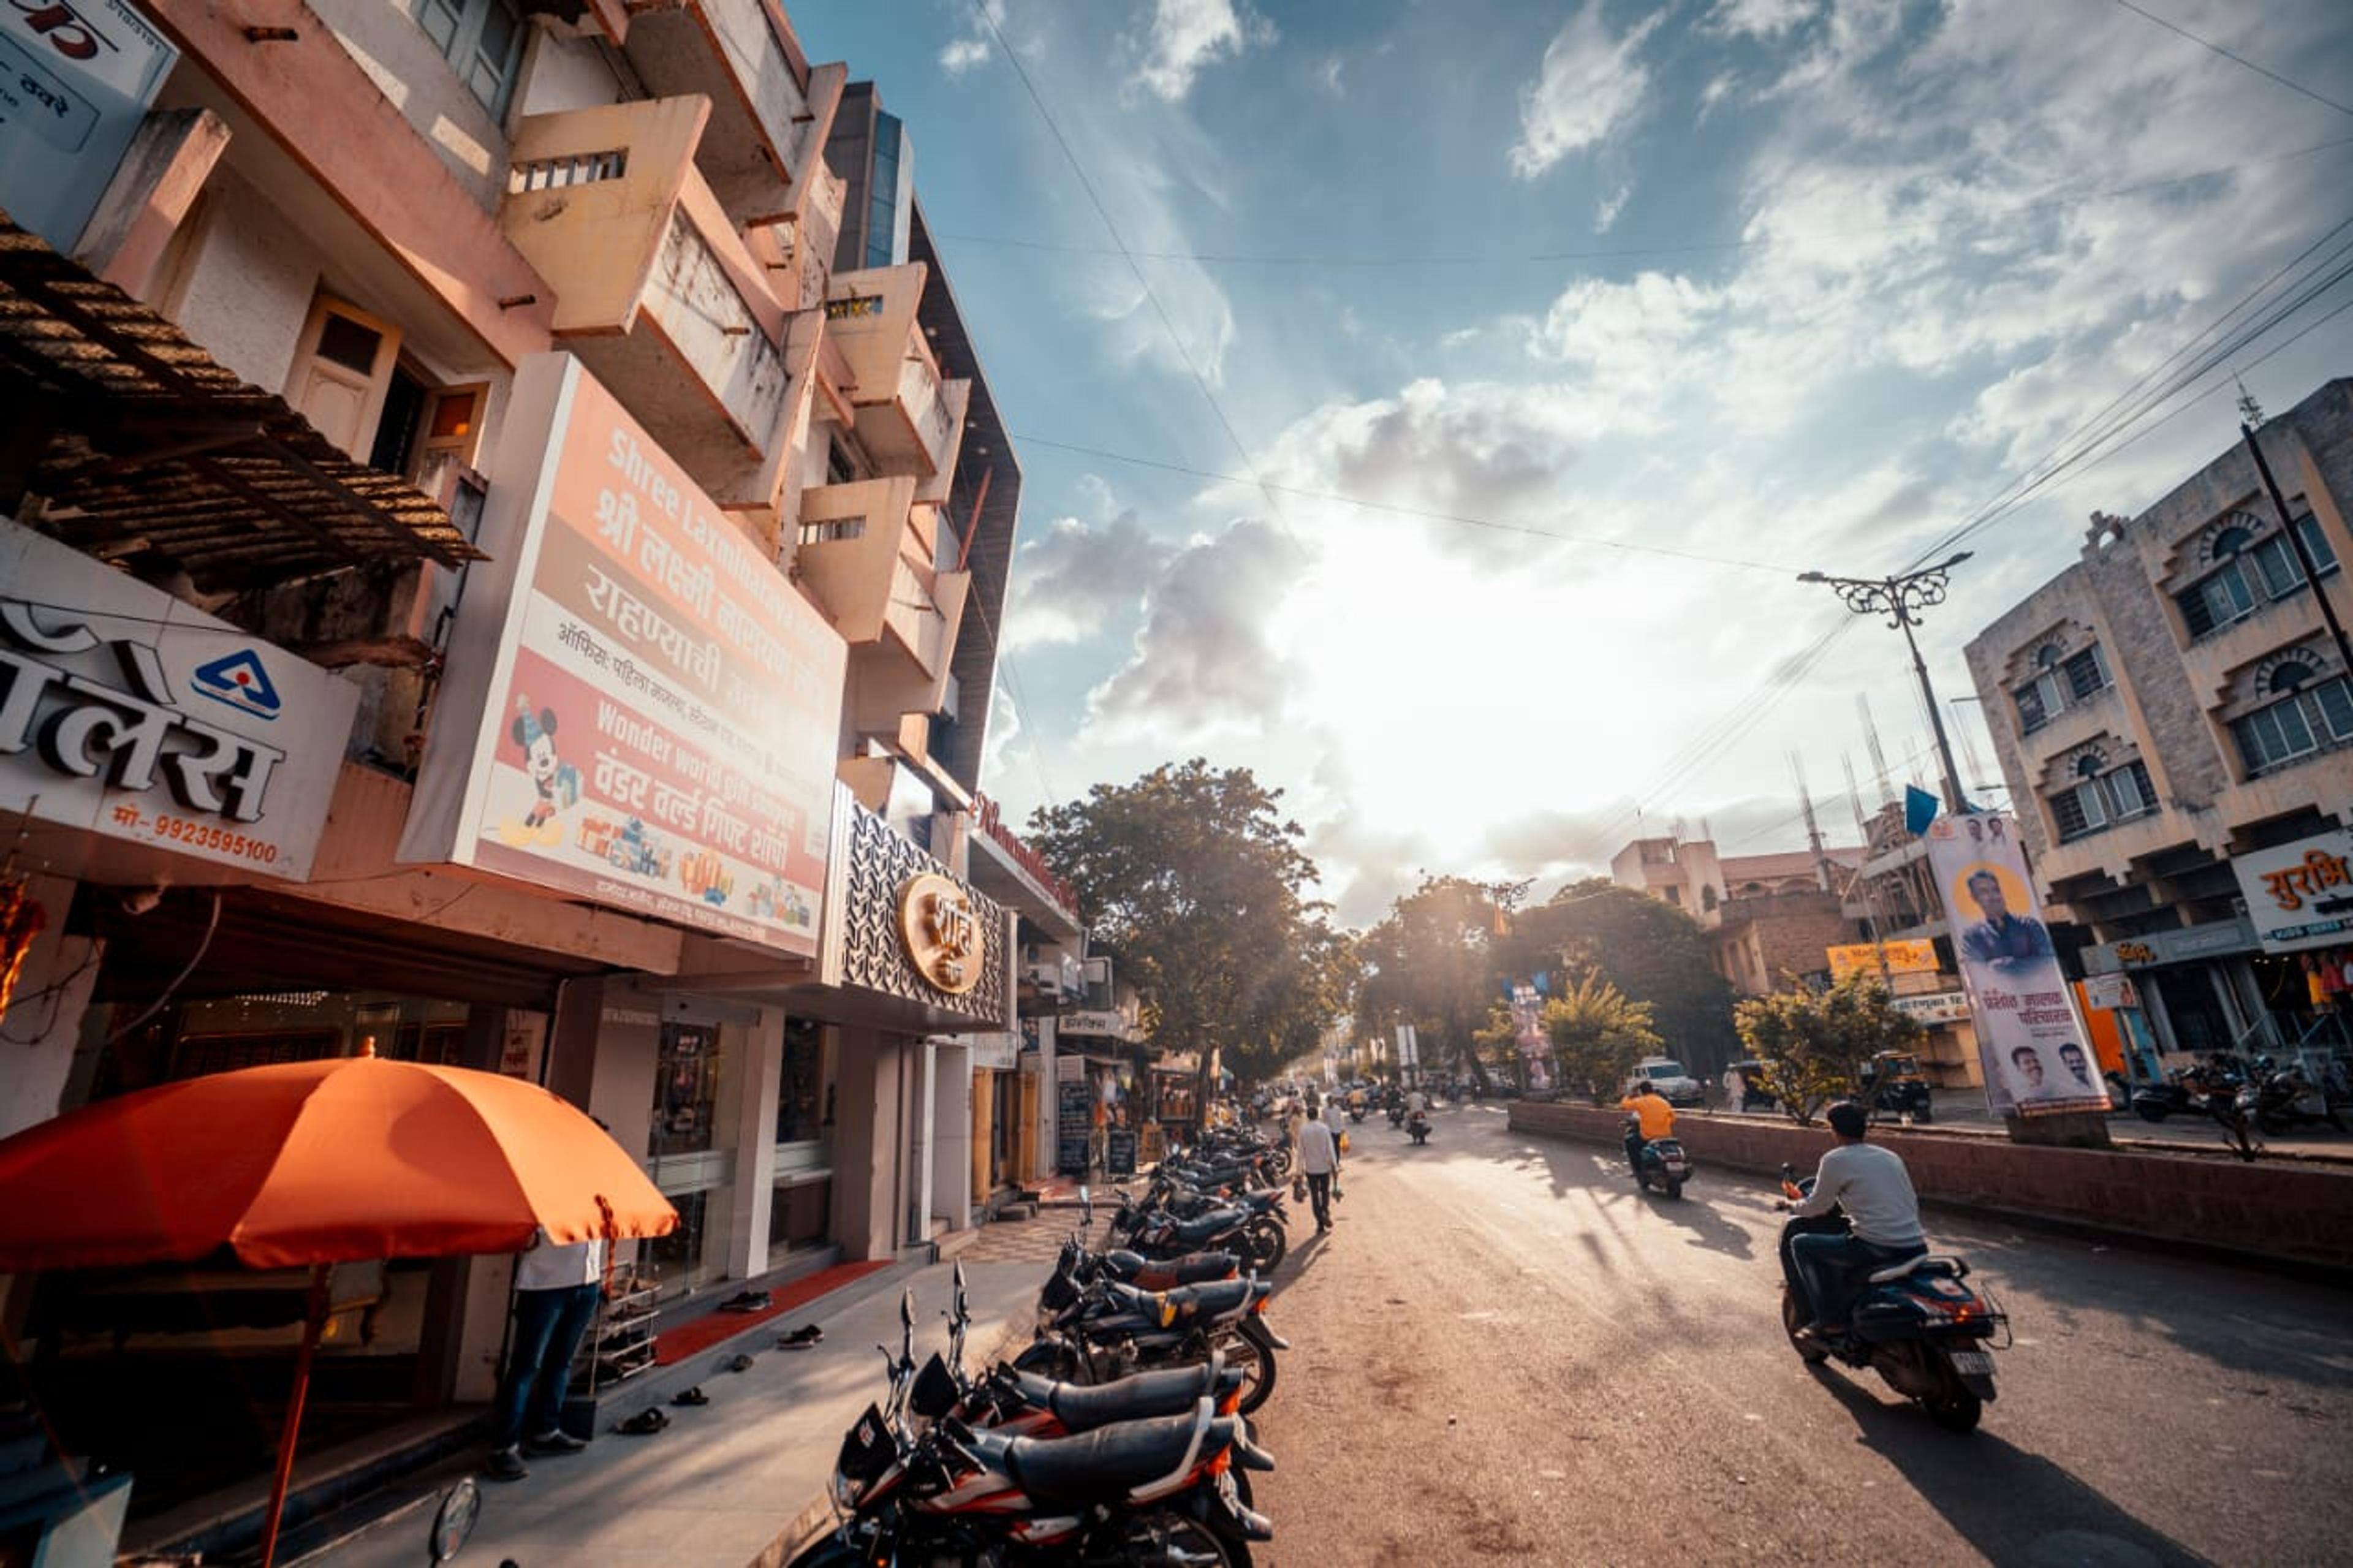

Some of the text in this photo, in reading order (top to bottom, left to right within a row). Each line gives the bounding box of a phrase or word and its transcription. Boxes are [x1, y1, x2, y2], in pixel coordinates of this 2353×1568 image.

[606, 427, 681, 518] Shree
[594, 487, 638, 556] श्री
[597, 699, 672, 763] Wonder
[156, 816, 277, 864] 9923595100
